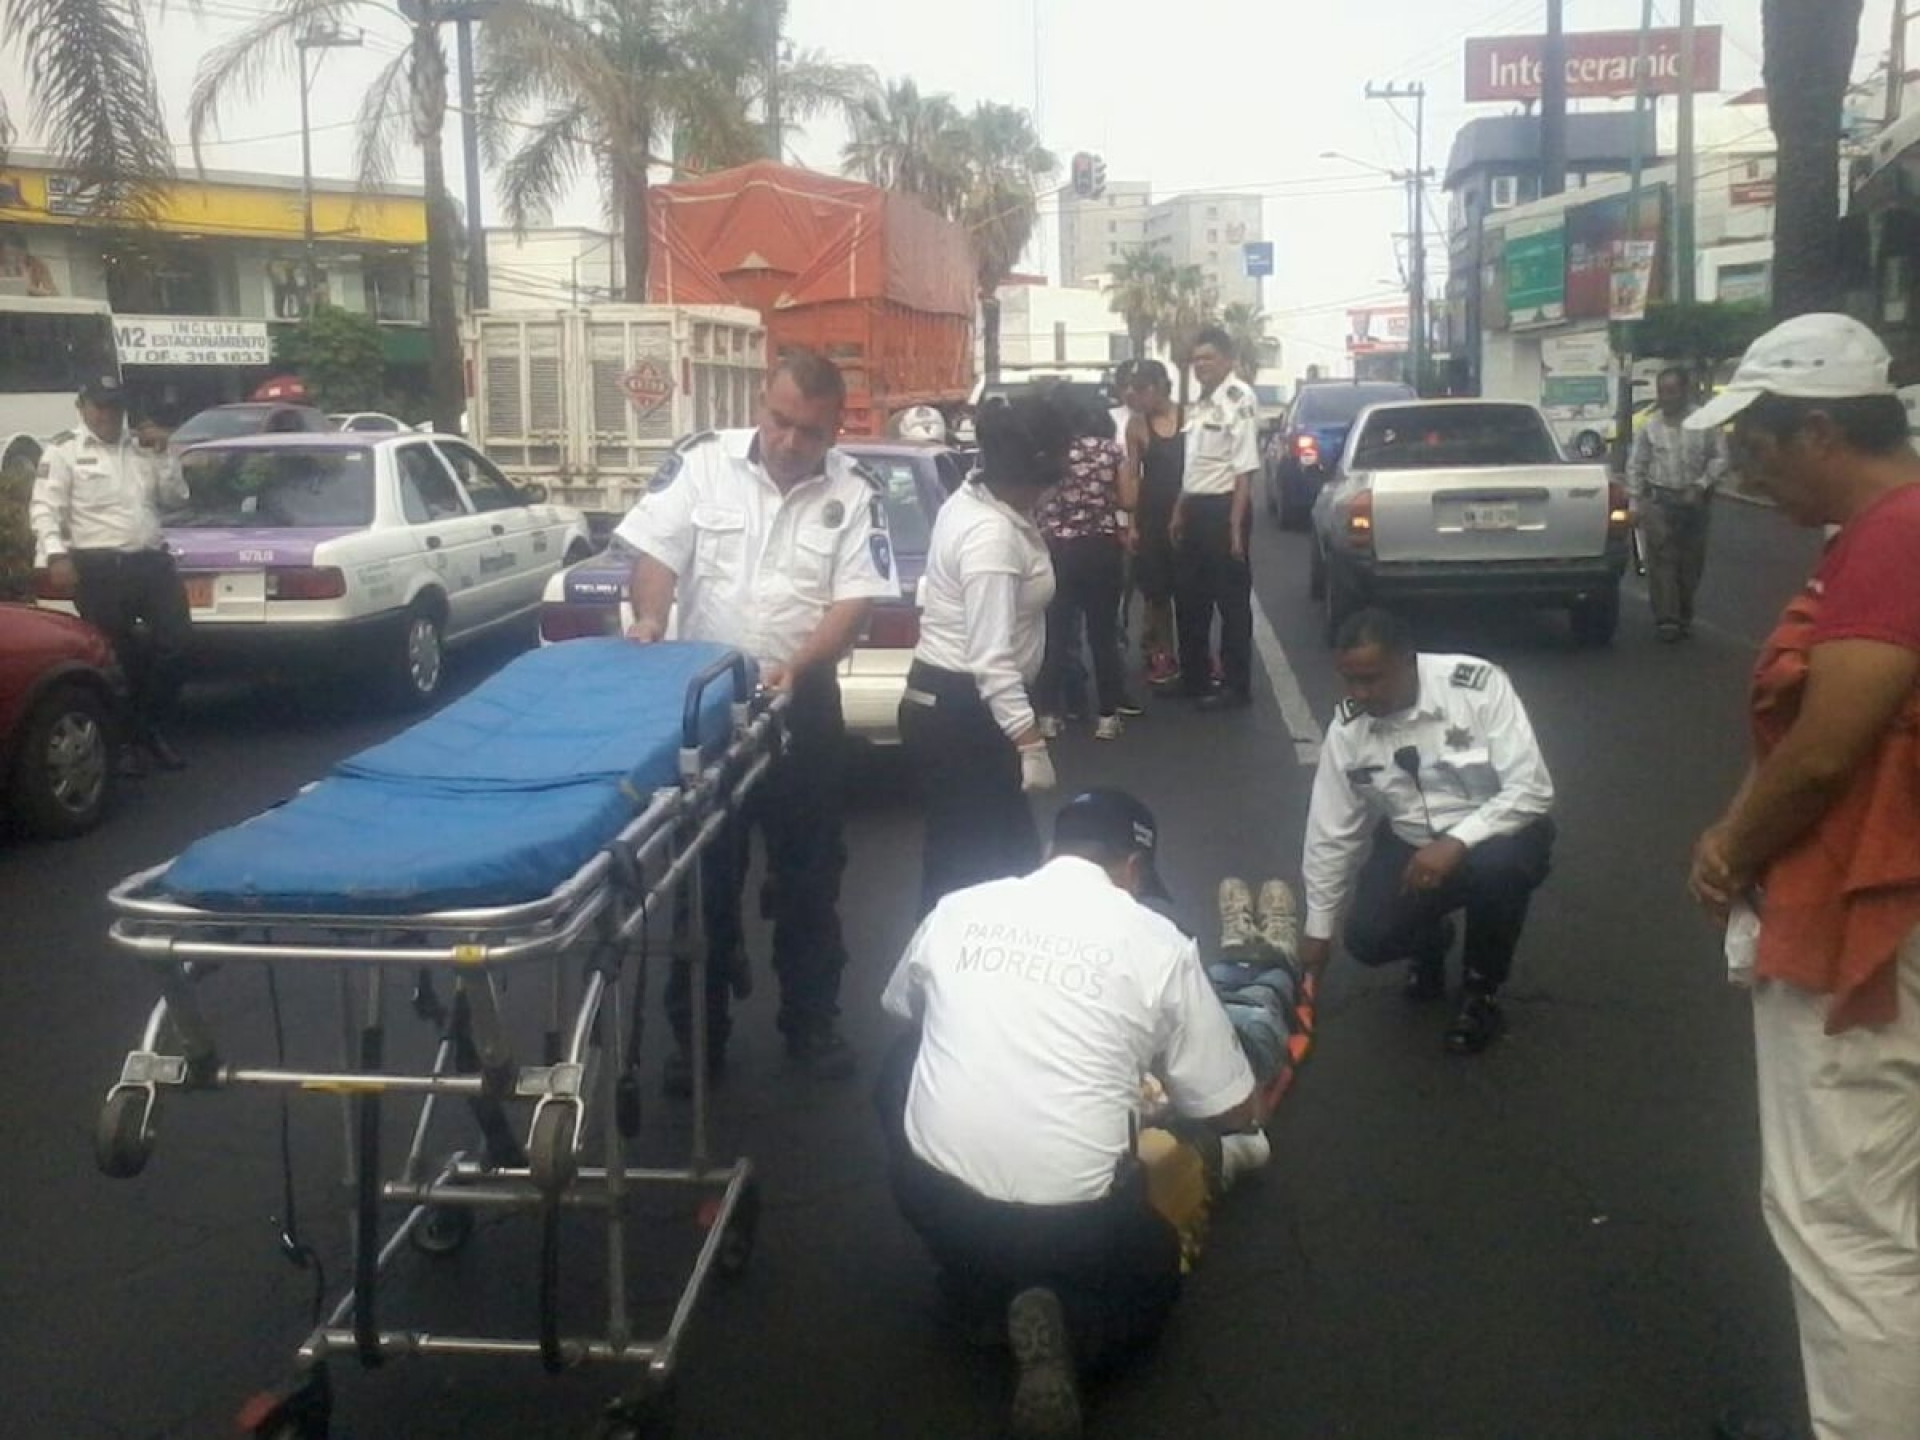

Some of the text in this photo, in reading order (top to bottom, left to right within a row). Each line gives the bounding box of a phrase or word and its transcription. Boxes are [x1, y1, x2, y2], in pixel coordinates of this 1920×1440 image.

[1490, 45, 1681, 87] Inteceramic
[964, 922, 1115, 967] PARAMEDICO
[955, 946, 1103, 1000] MORELOS
